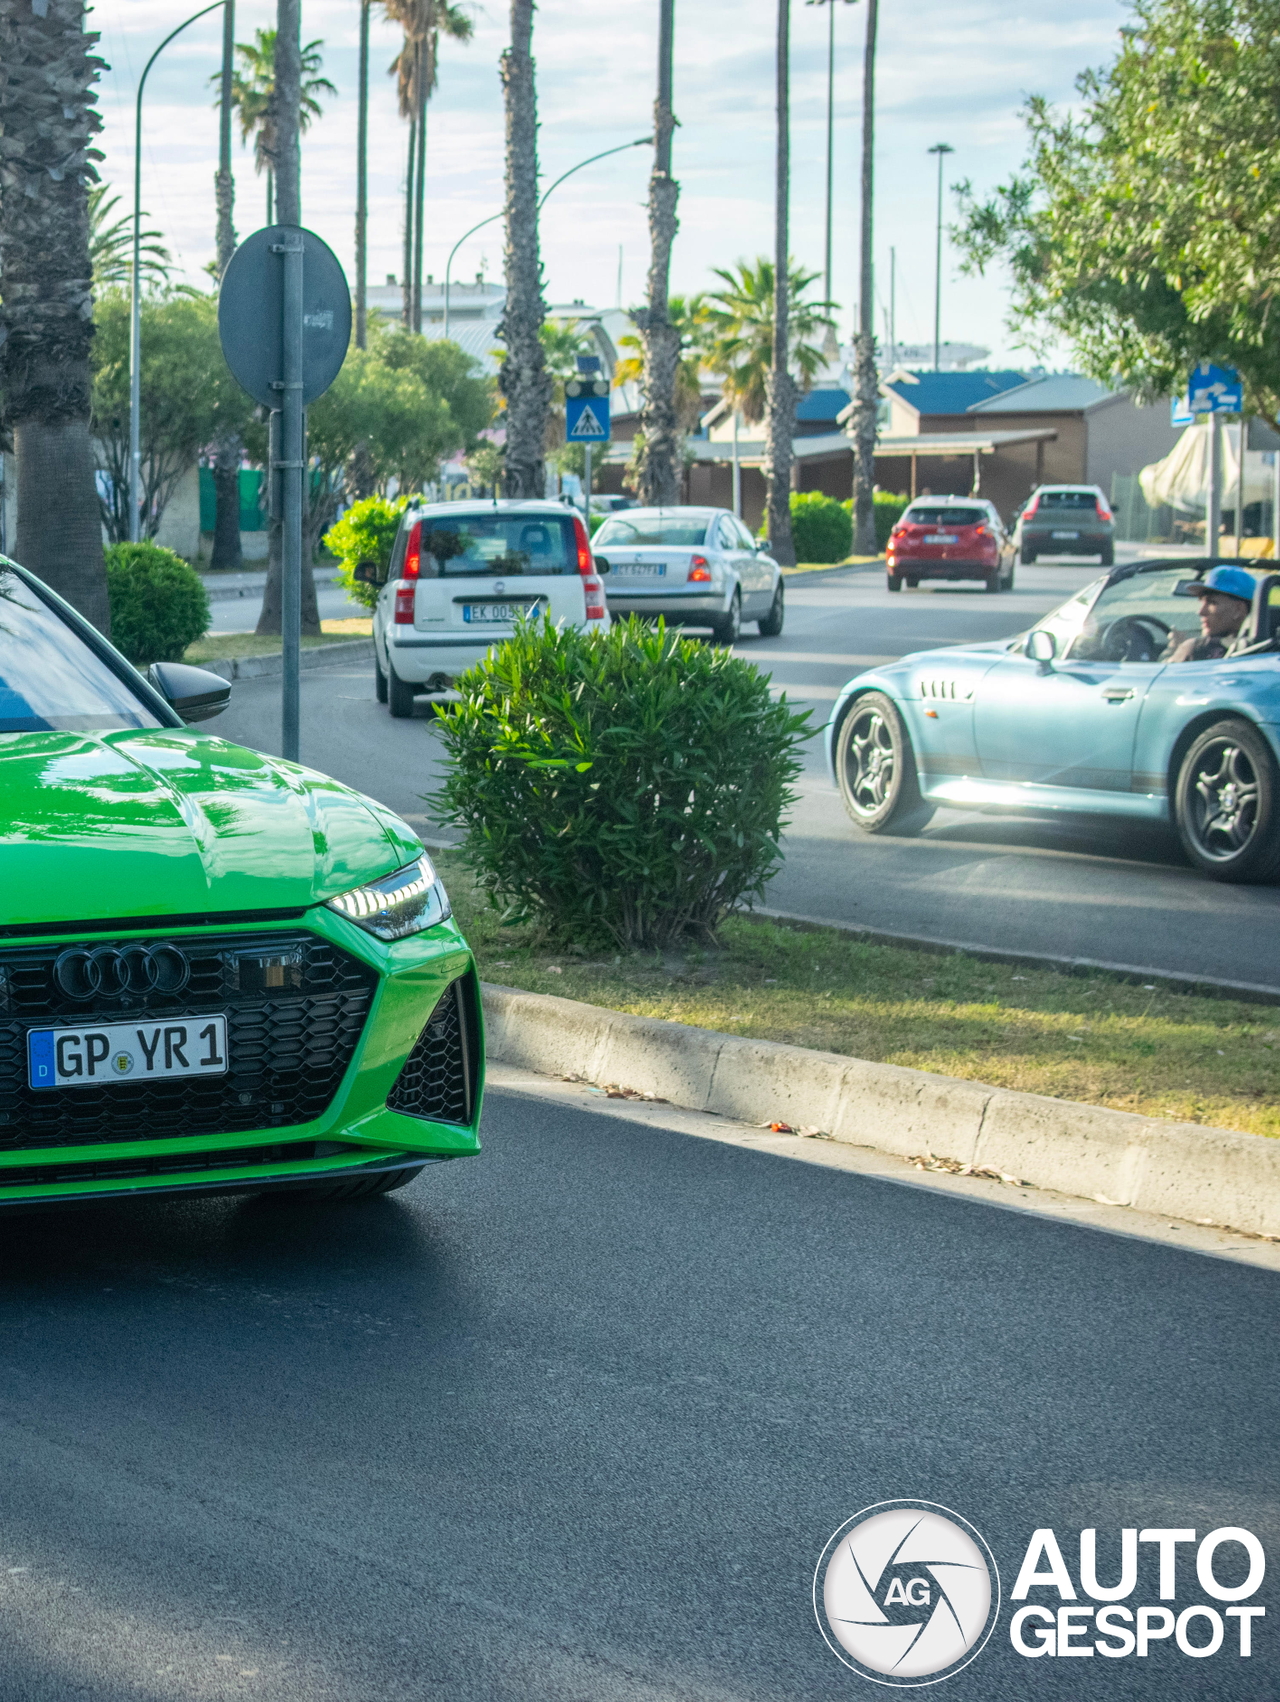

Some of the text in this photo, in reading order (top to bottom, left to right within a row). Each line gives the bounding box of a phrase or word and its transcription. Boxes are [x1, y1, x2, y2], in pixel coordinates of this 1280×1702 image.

[472, 605, 490, 619] EK
[38, 1023, 223, 1077] D GP YR 1
